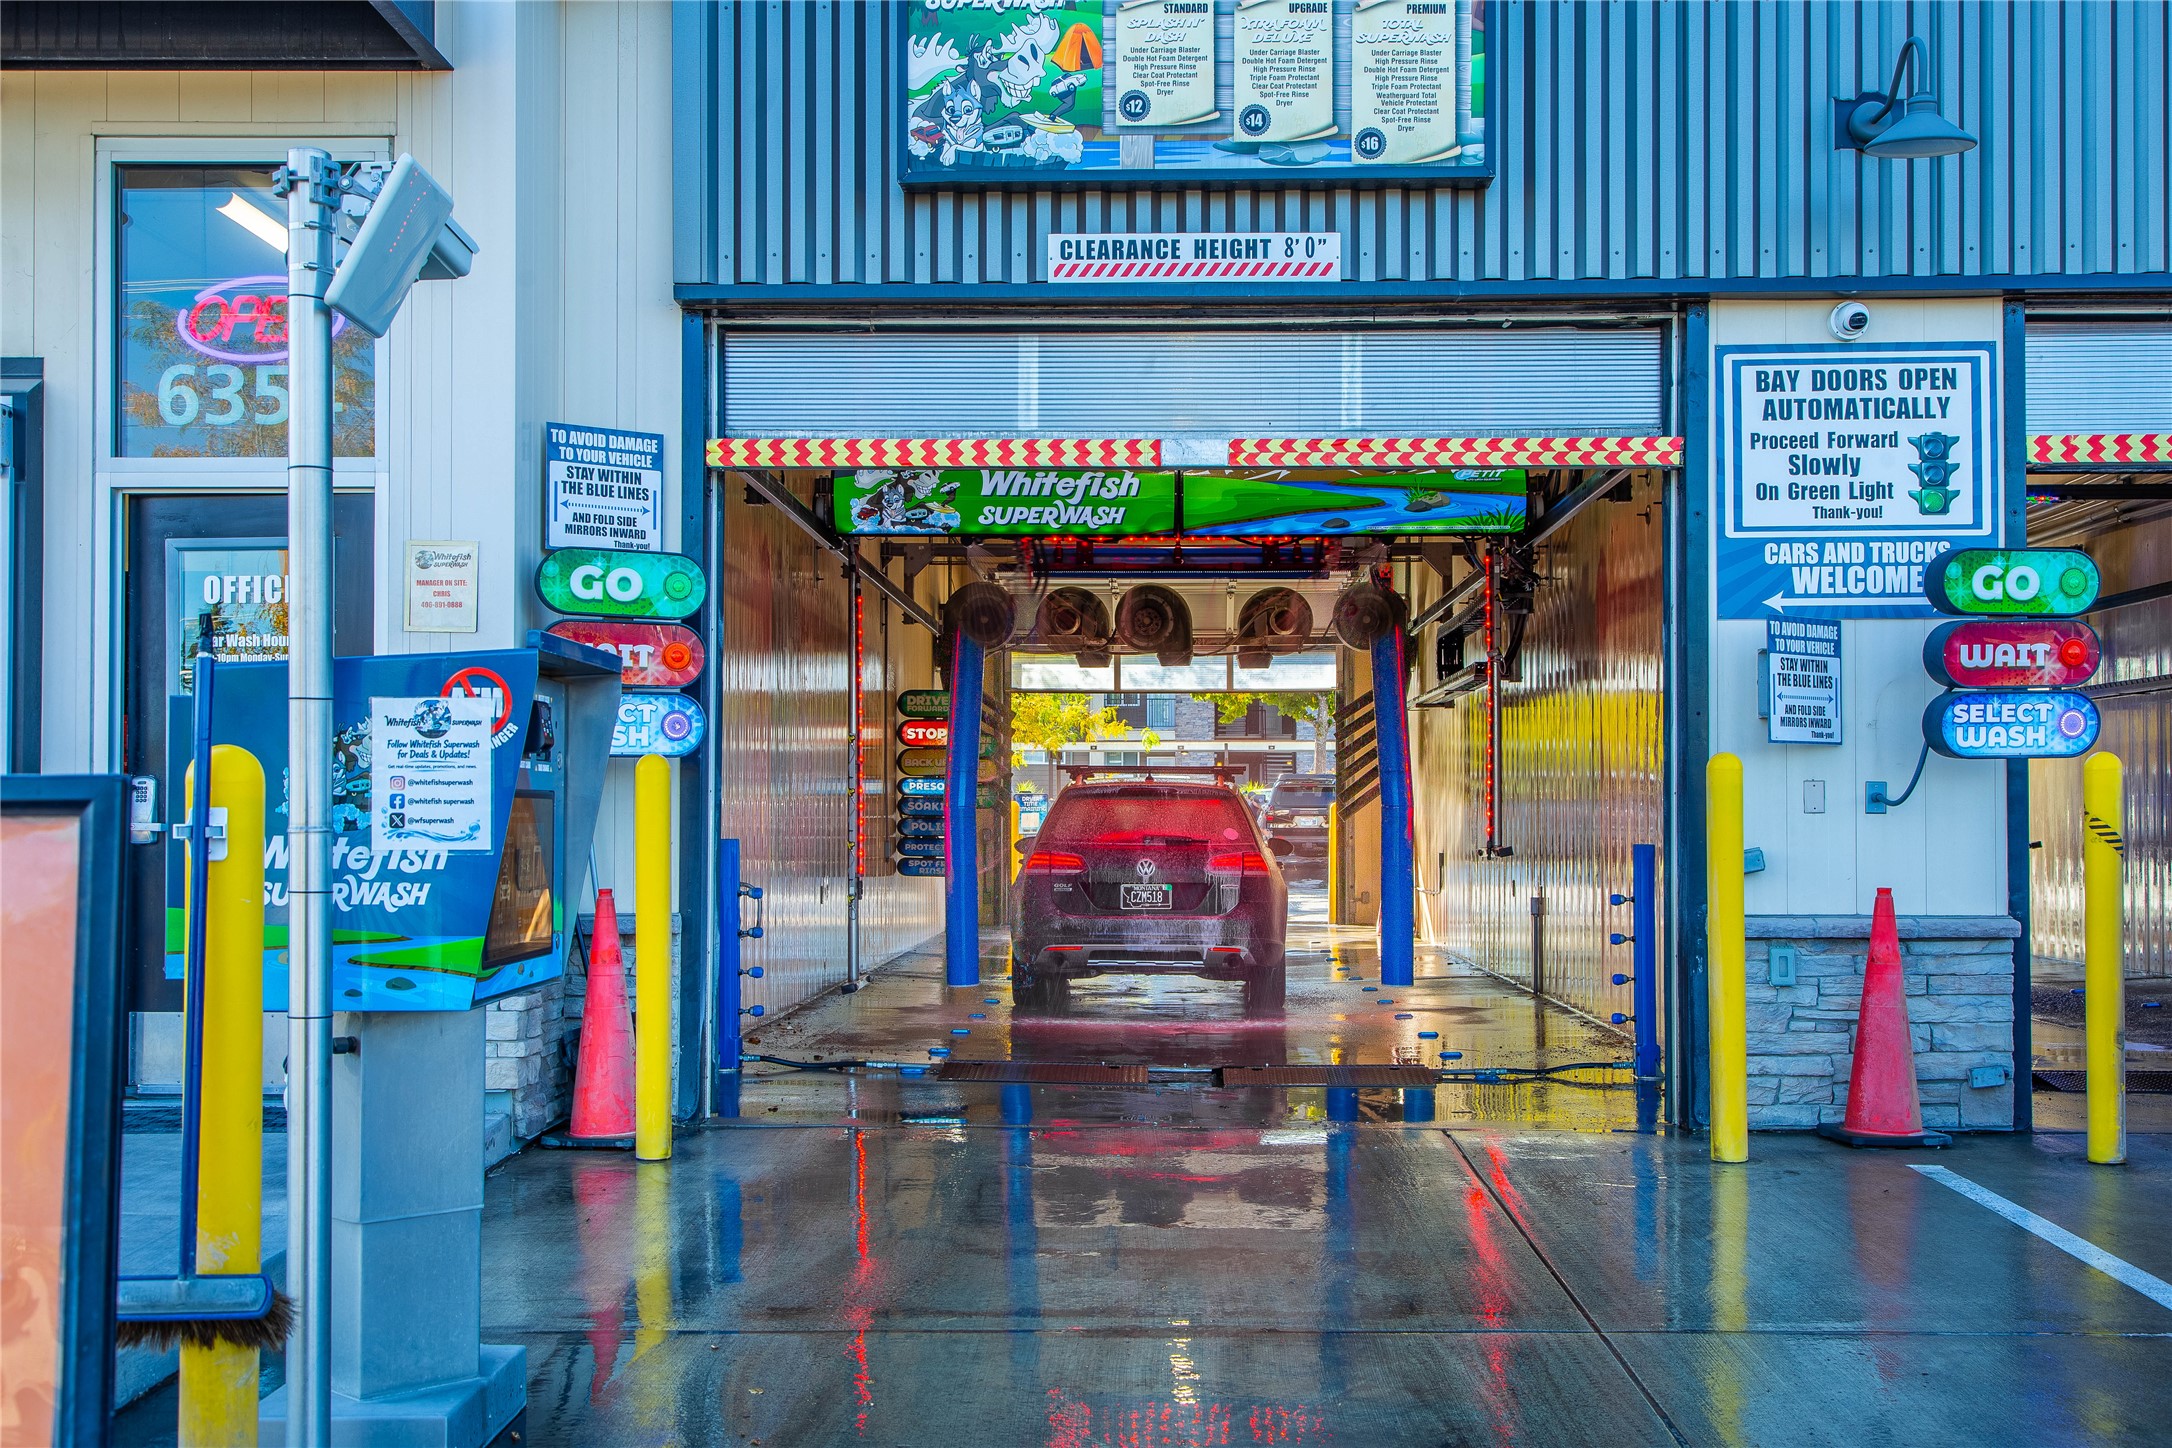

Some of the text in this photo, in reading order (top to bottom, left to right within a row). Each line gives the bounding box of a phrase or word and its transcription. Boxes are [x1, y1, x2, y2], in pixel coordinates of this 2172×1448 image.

[1164, 4, 1208, 14] STANDARD
[1289, 3, 1328, 13] UPGRADE
[1407, 4, 1446, 14] PREMIUM
[1127, 19, 1186, 31] SPLASH
[1280, 19, 1328, 32] FOAM
[1382, 19, 1424, 32] TOTAL
[1145, 32, 1187, 45] DASH
[1252, 31, 1314, 43] DELUXE
[1355, 31, 1452, 45] SUPERWASH
[1178, 55, 1208, 63] Detergent
[1375, 58, 1389, 66] High
[1141, 80, 1170, 88] Spot-Free
[1250, 74, 1267, 82] Triple
[1376, 92, 1420, 100] Weatherguard
[1126, 100, 1143, 113] $12
[1246, 113, 1263, 127] $14
[1361, 137, 1379, 150] $16
[1060, 239, 1181, 260] CLEARANCE
[1194, 238, 1272, 260] HEIGHT
[188, 295, 288, 343] OPE
[1755, 367, 1957, 393] BAY DOORS OPEN
[1762, 396, 1951, 422] AUTOMATICALLY
[551, 429, 658, 453] TO AVOID DAMAGE
[1750, 431, 1898, 450] Proceed Forward
[559, 446, 653, 468] TO YOUR VEHICLE
[1789, 453, 1861, 478] Slowly
[566, 466, 642, 485] STAY WITHIN
[561, 481, 649, 501] THE BLUE LINES
[980, 469, 1140, 505] Whitefish
[1756, 481, 1894, 502] On Green Light
[977, 499, 1127, 530] SUPERWASH
[1812, 505, 1883, 520] Thank-you!
[572, 512, 637, 527] AND FOLD SIDE
[565, 524, 646, 540] MIRRORS INWARD
[614, 540, 651, 550] Thank-you!
[433, 551, 472, 564] Whitefish
[1764, 543, 1818, 564] CARS
[1823, 542, 1865, 564] AND
[433, 561, 468, 569] SUPERWASH
[570, 565, 643, 600] GO
[1792, 565, 1923, 595] WELCOME
[1972, 565, 2041, 601] GO
[1770, 621, 1838, 640] TO AVOID DAMAGE
[226, 634, 289, 647] Wash Hou
[1775, 638, 1835, 656] TO YOUR VEHICLE
[1960, 642, 2051, 668] WAIT
[1780, 657, 1828, 674] STAY WITHIN
[1777, 673, 1833, 689] THE BLUE LINES
[906, 695, 949, 706] DRIVE
[1785, 704, 1826, 716] AND FOLD SIDE
[1953, 703, 2054, 725] SELECT
[384, 715, 422, 729] Whitefish
[1780, 716, 1832, 729] MIRRORS INWARD
[906, 728, 947, 740] STOP
[1955, 726, 2046, 748] WASH
[387, 740, 480, 750] Follow Whitefish Superwash
[397, 750, 470, 760] for Deals & Updates!
[905, 759, 932, 767] BACK
[408, 779, 473, 787] @whitefishsuperwash
[909, 782, 945, 791] PRESO
[408, 798, 475, 806] @whitefish superwash
[408, 817, 455, 825] @wfsuperwash
[911, 822, 945, 831] POLIS
[264, 874, 431, 913] SURWASH
[1131, 891, 1163, 903] CZM518
